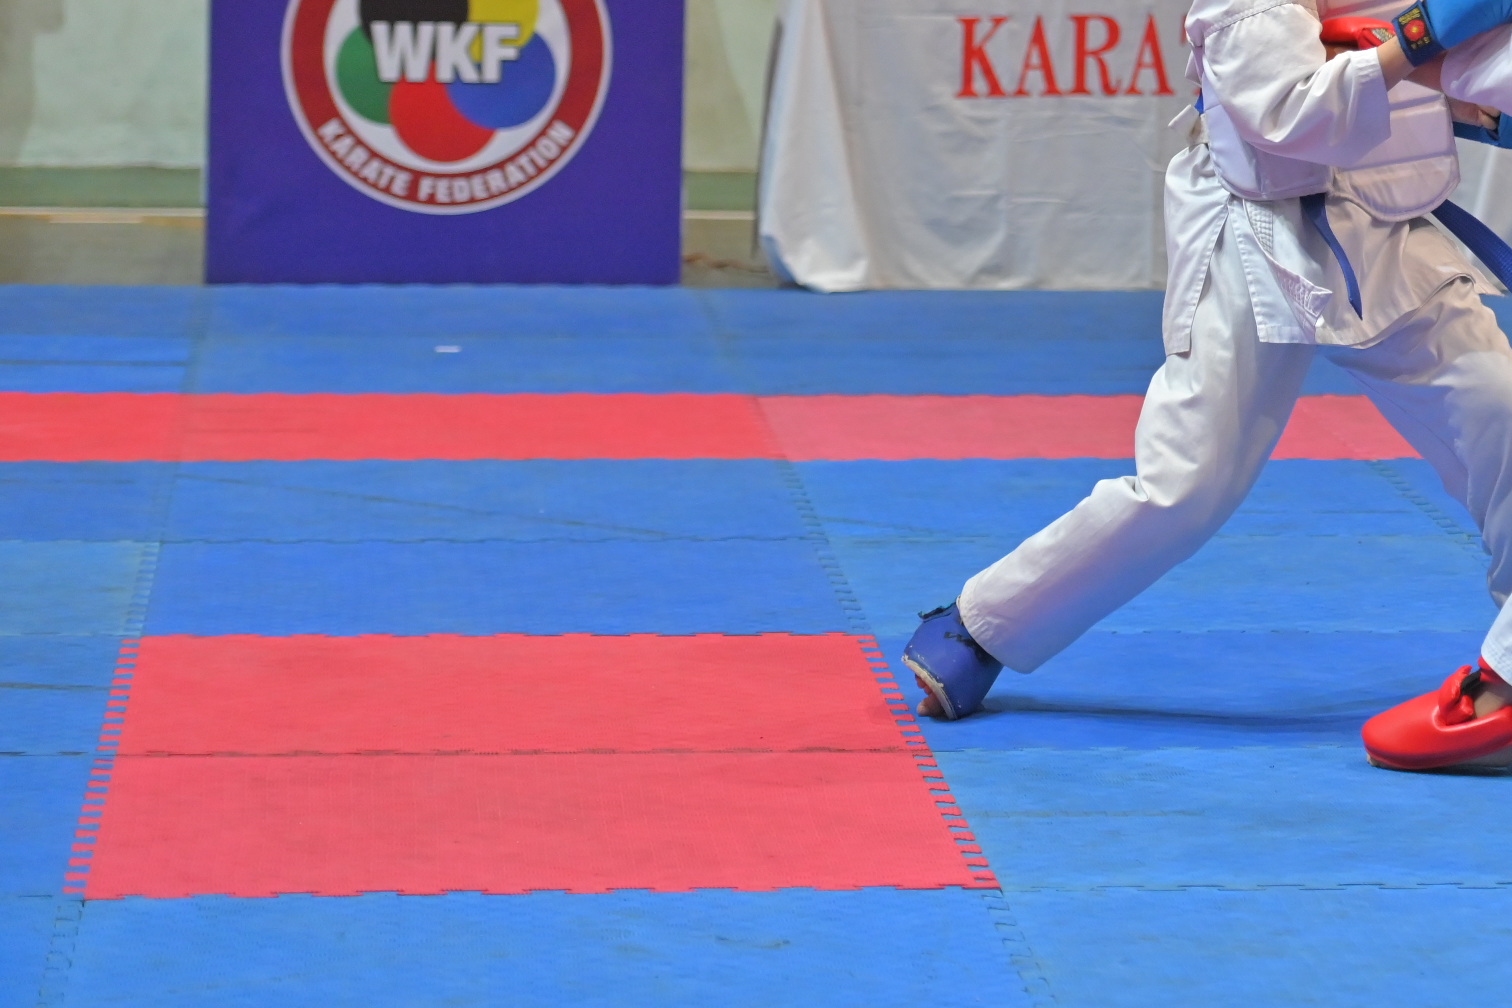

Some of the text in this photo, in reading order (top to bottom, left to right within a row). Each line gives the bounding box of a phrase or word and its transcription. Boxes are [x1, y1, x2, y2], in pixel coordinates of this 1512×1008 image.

[371, 21, 520, 83] WKF
[954, 13, 1190, 98] KARA
[316, 118, 575, 204] KARATE FEDERATION
